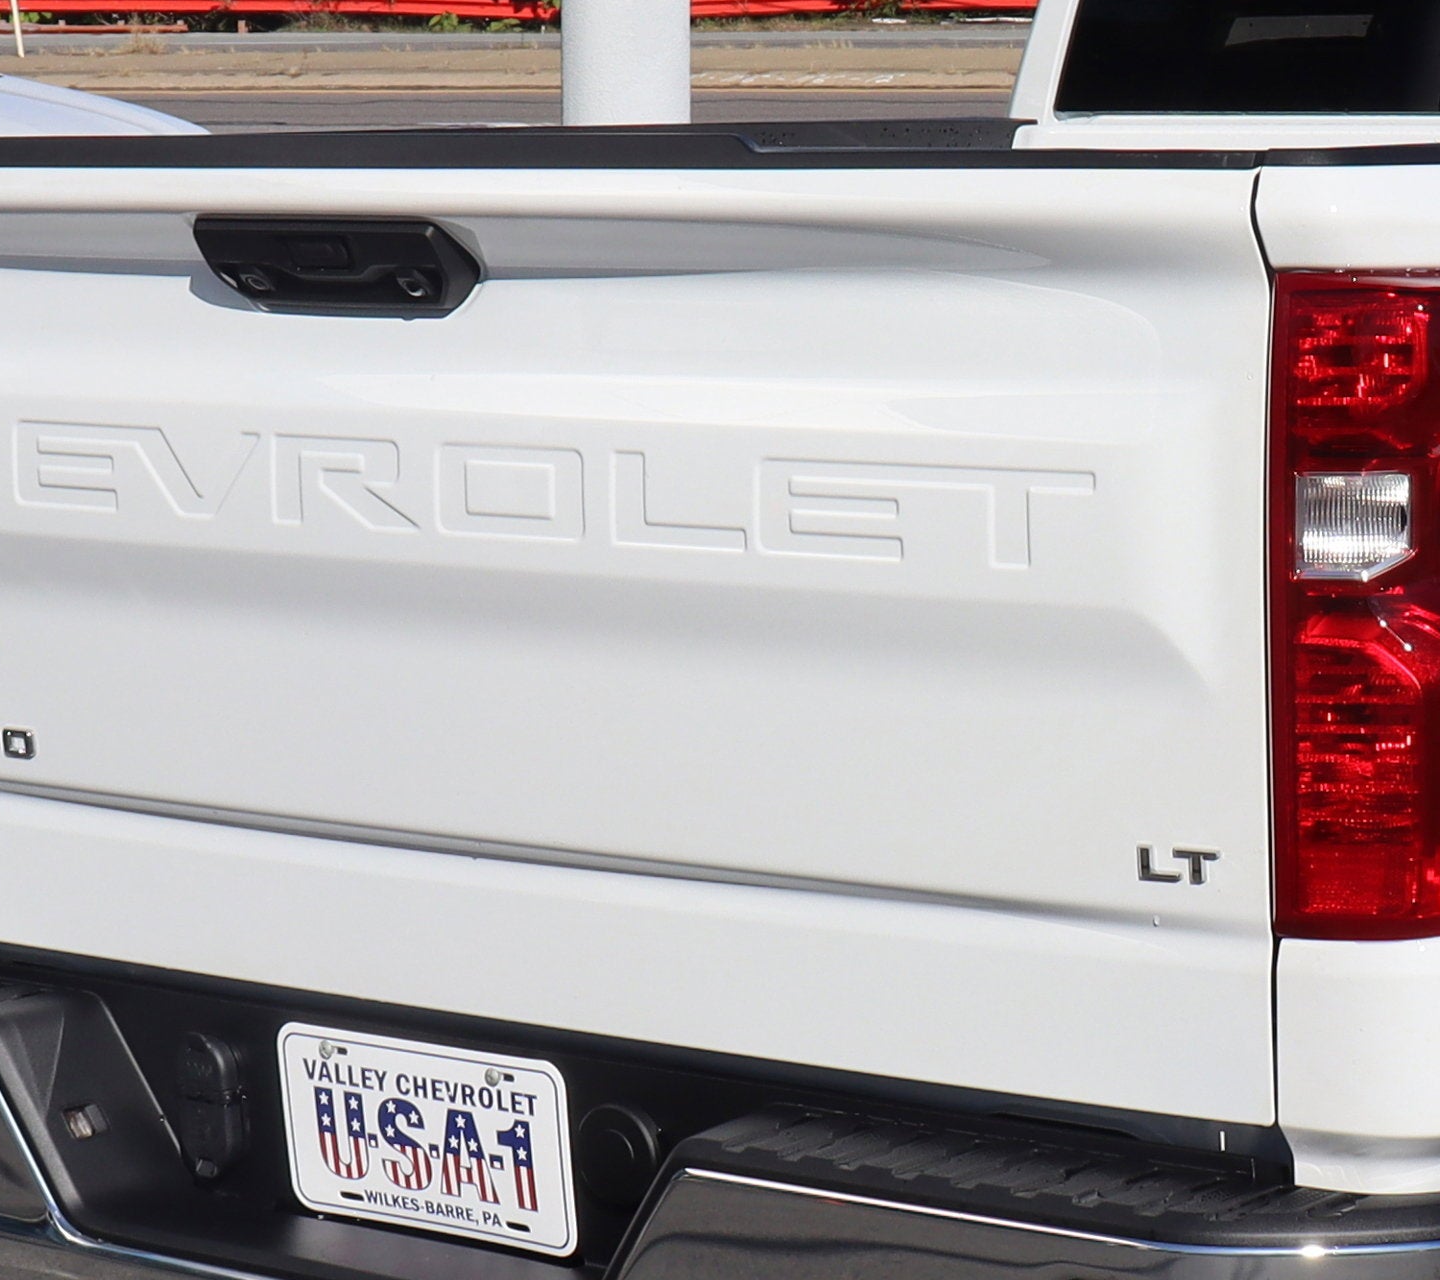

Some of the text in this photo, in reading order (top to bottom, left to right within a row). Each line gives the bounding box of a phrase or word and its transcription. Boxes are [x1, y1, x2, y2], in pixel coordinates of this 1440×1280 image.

[1136, 844, 1221, 885] LT
[302, 1057, 538, 1117] VALLEY CHEVROLET
[482, 1210, 502, 1228] PA
